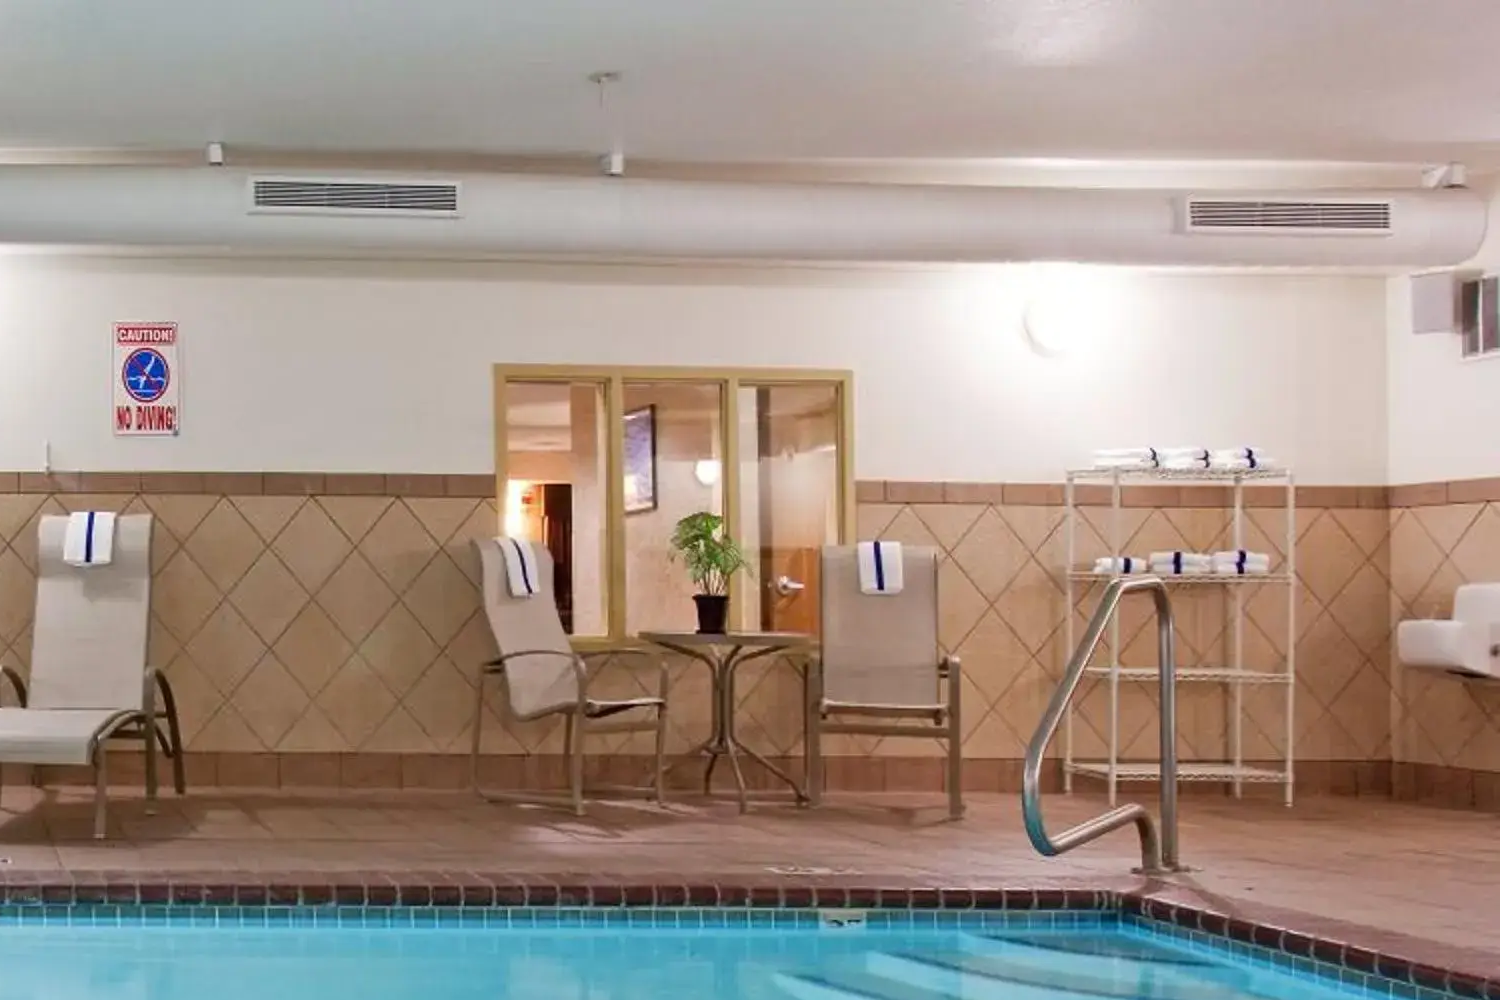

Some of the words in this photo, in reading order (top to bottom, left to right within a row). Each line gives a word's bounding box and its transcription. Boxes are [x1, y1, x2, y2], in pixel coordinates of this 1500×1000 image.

[119, 329, 173, 341] CAUTION!
[117, 405, 132, 430] NO
[136, 405, 177, 430] DIVING!
